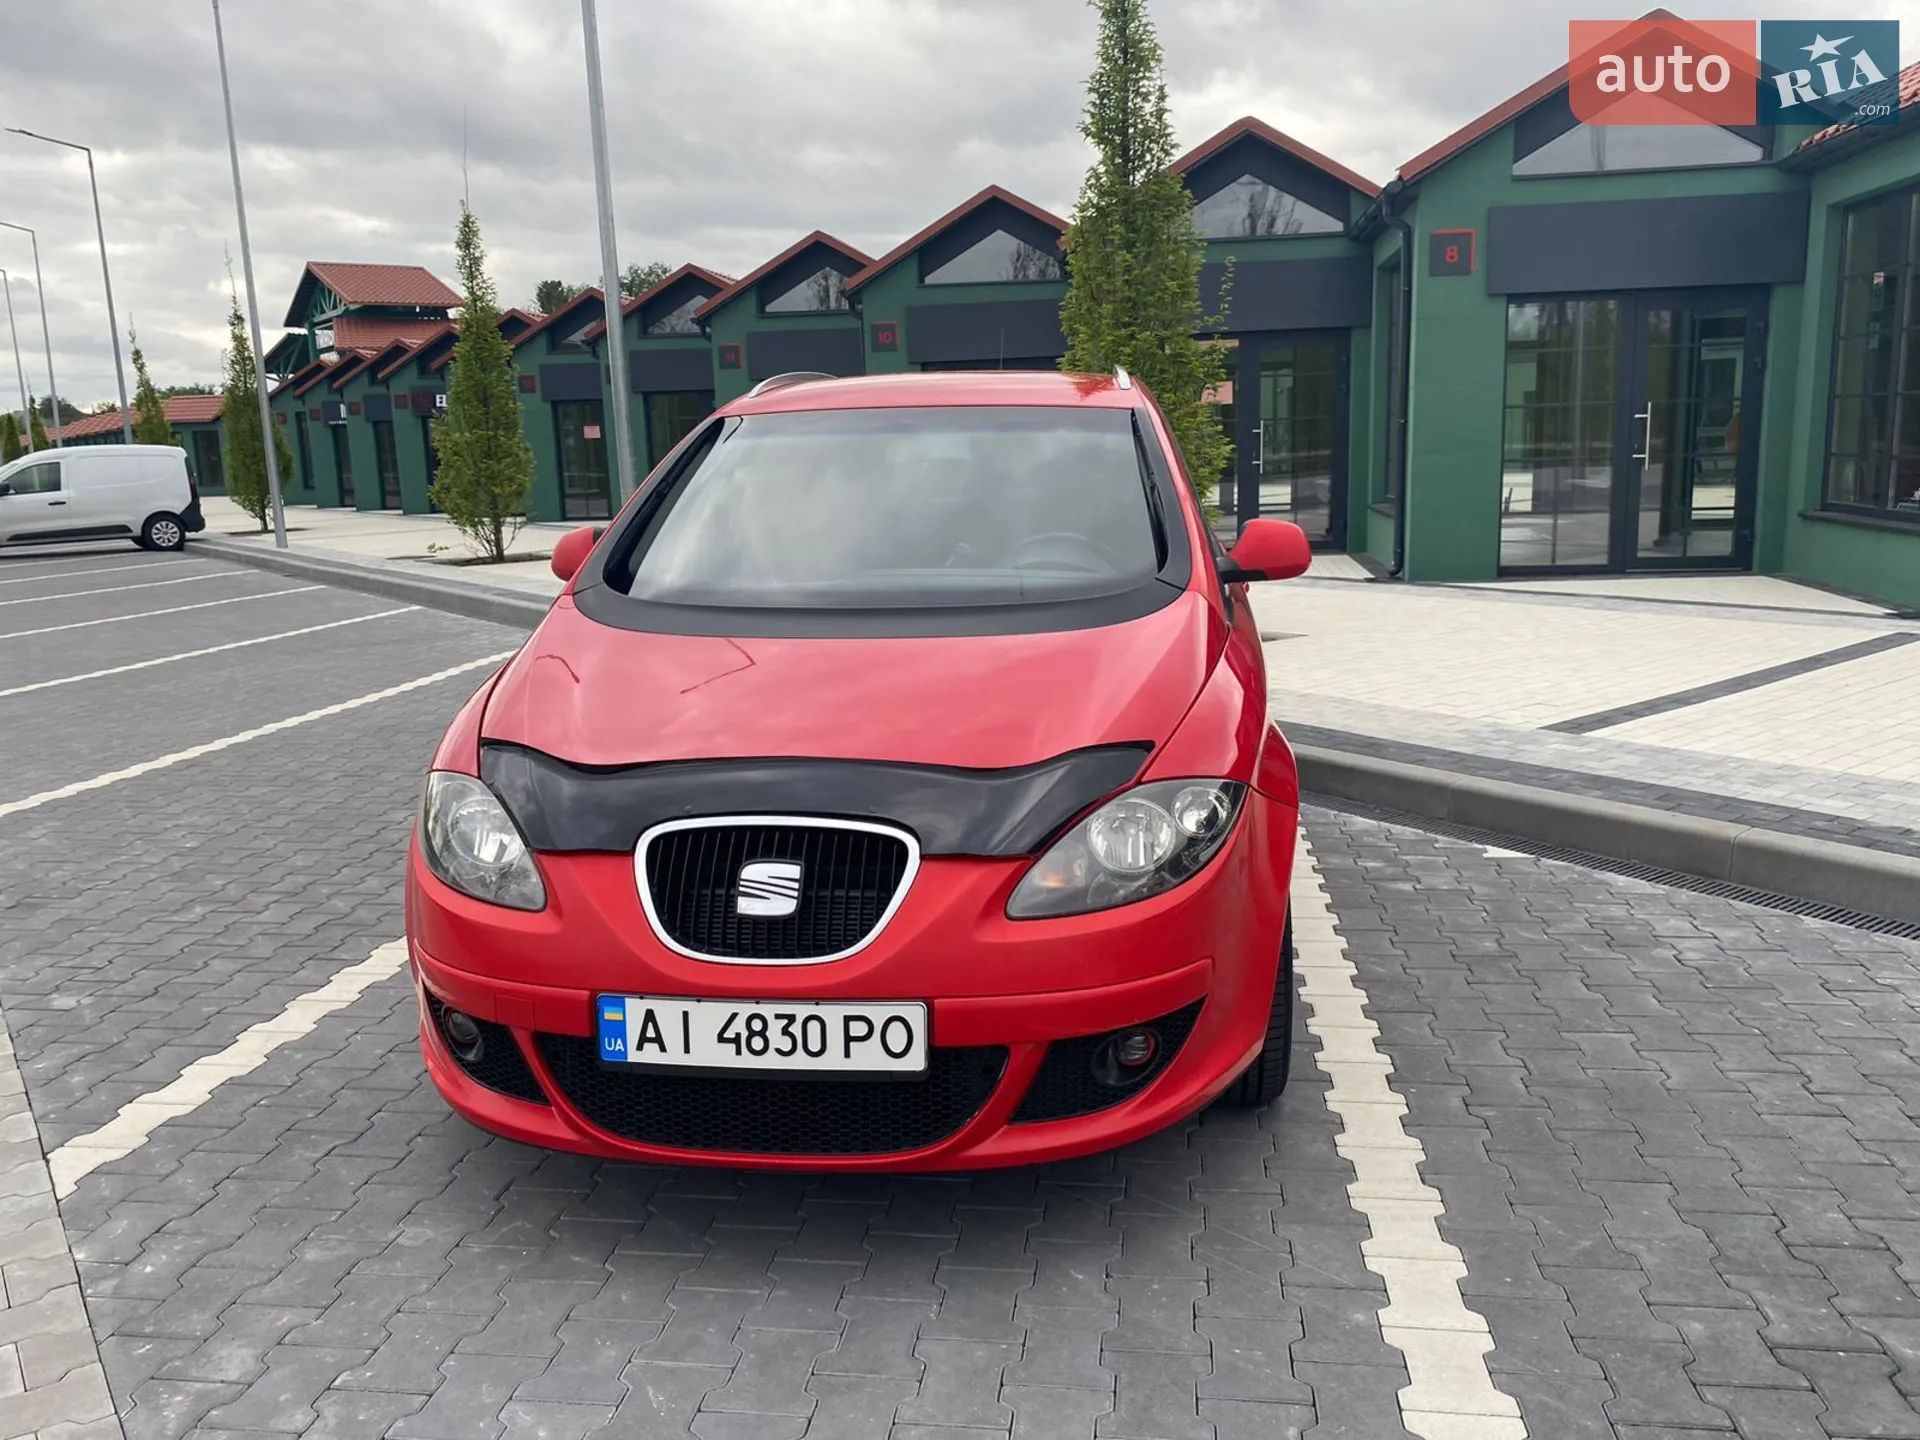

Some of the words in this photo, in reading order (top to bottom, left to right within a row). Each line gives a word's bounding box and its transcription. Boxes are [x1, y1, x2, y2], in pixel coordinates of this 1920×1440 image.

[1445, 245, 1458, 263] 8
[878, 331, 892, 344] 10
[716, 1011, 828, 1059] 4830
[843, 1014, 914, 1060] PO
[604, 1037, 625, 1052] UA
